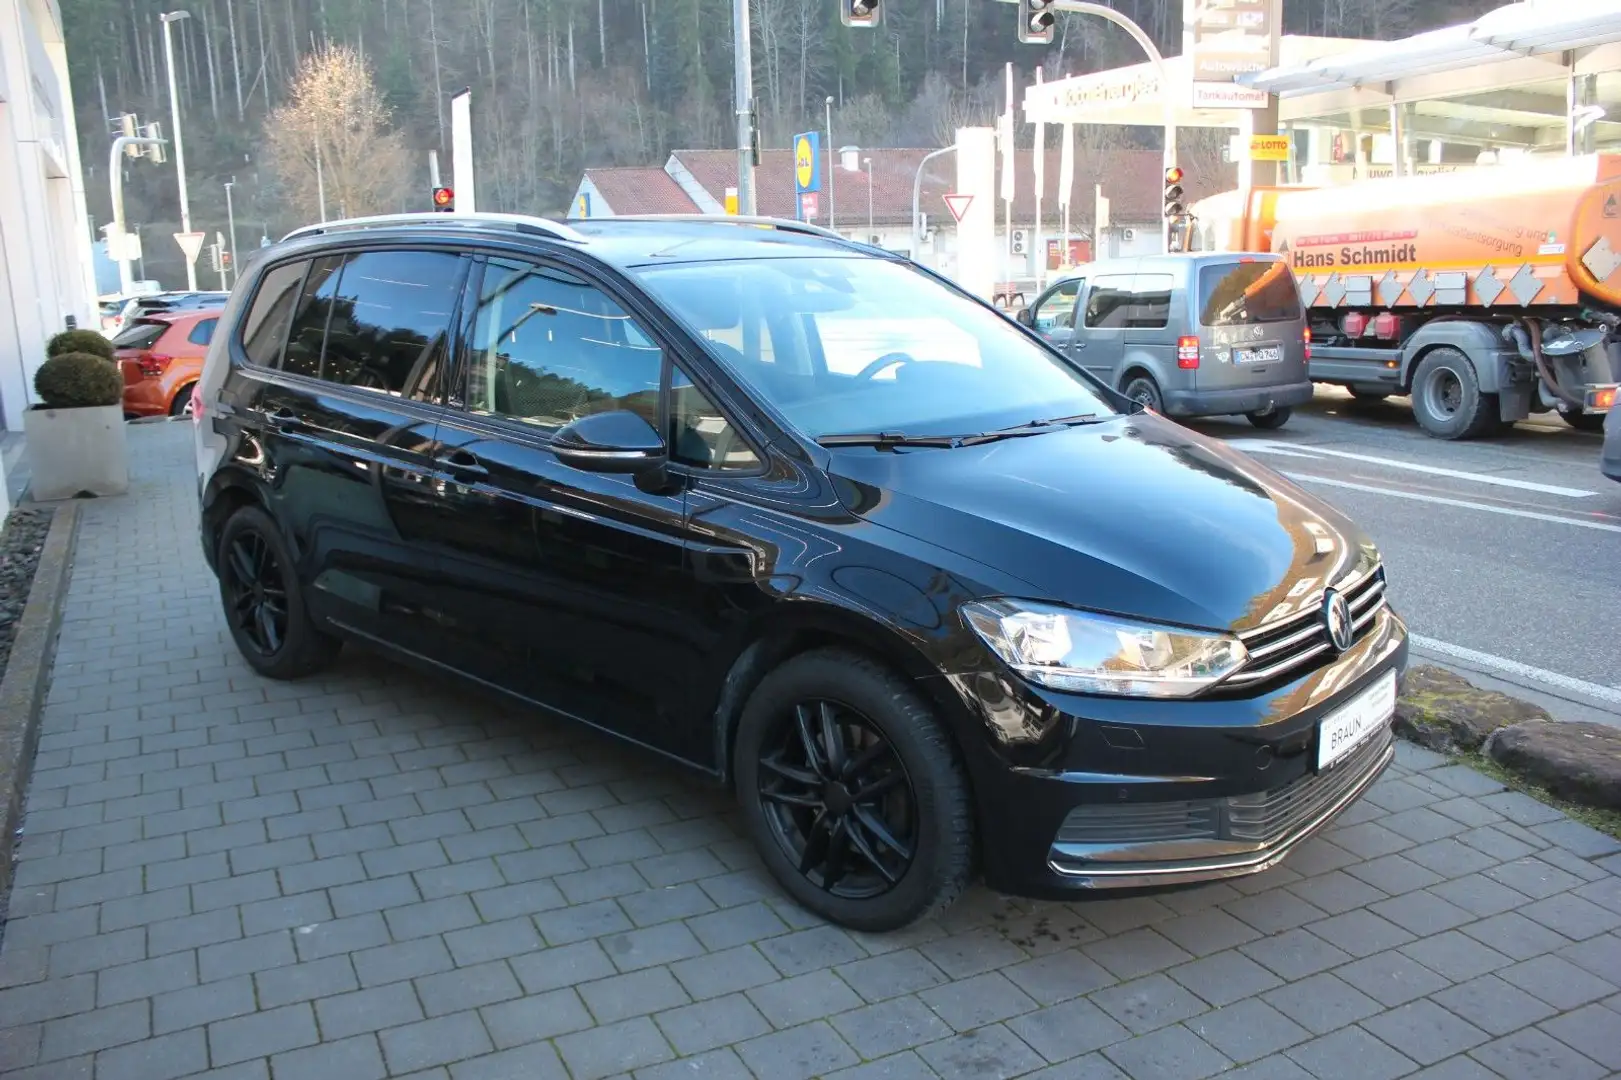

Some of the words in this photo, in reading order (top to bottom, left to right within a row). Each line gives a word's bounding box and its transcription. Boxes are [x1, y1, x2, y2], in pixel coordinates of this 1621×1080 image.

[1261, 140, 1288, 150] LOTTO
[1293, 250, 1335, 268] Hans
[1340, 243, 1417, 265] Schmidt
[1331, 713, 1362, 750] BRAUN
